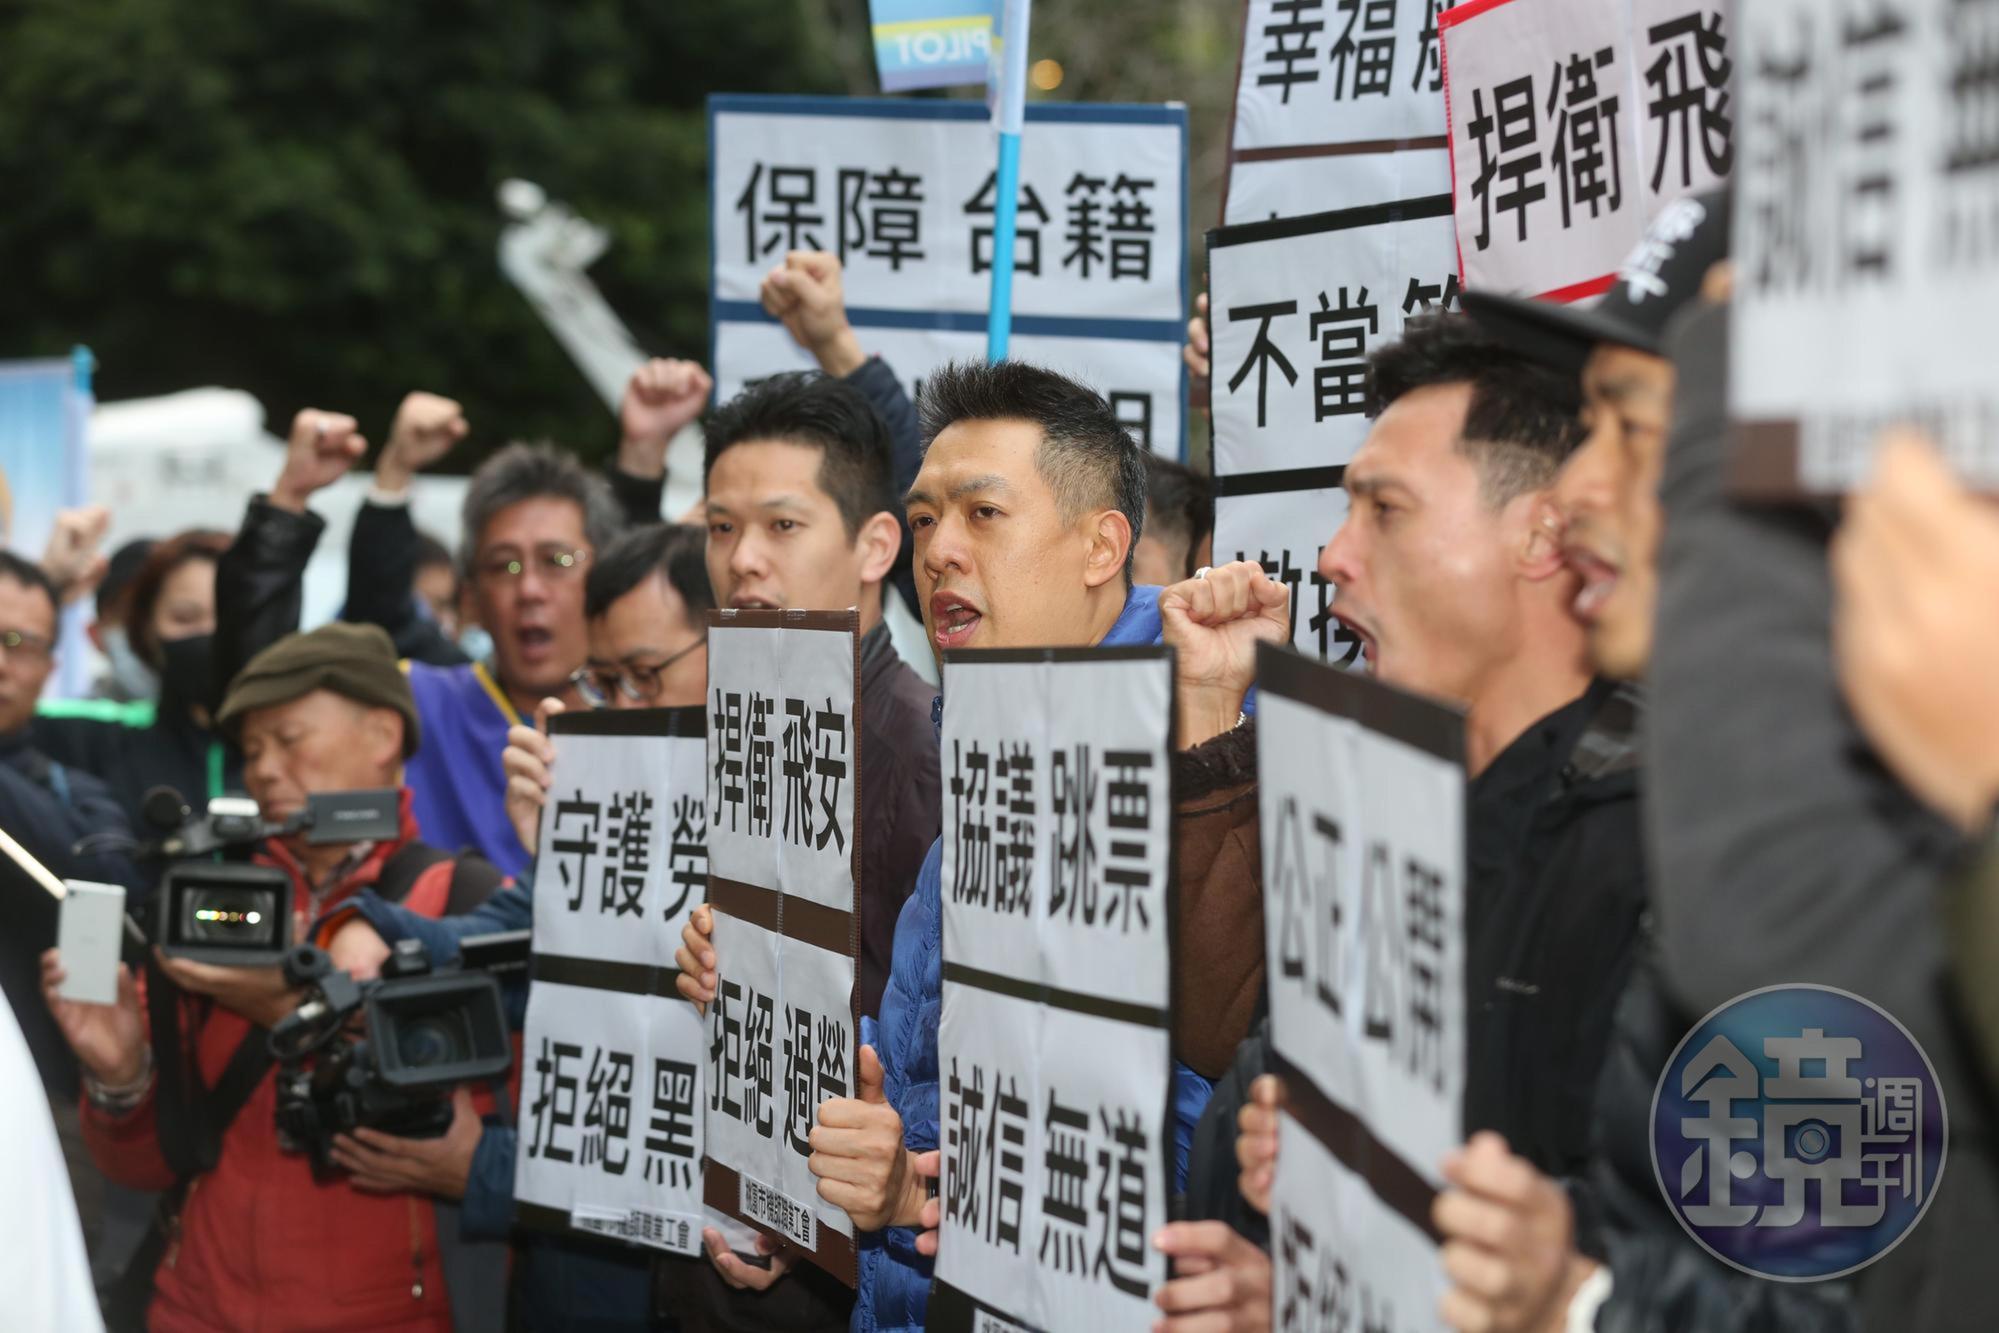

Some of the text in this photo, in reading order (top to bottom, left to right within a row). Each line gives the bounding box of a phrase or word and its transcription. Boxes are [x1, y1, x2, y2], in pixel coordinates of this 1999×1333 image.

[714, 688, 847, 856] 捍衛飛安
[950, 739, 1153, 934] 協議跳票
[528, 1037, 704, 1191] 拒絕黑
[947, 1056, 1149, 1300] 誠信無道
